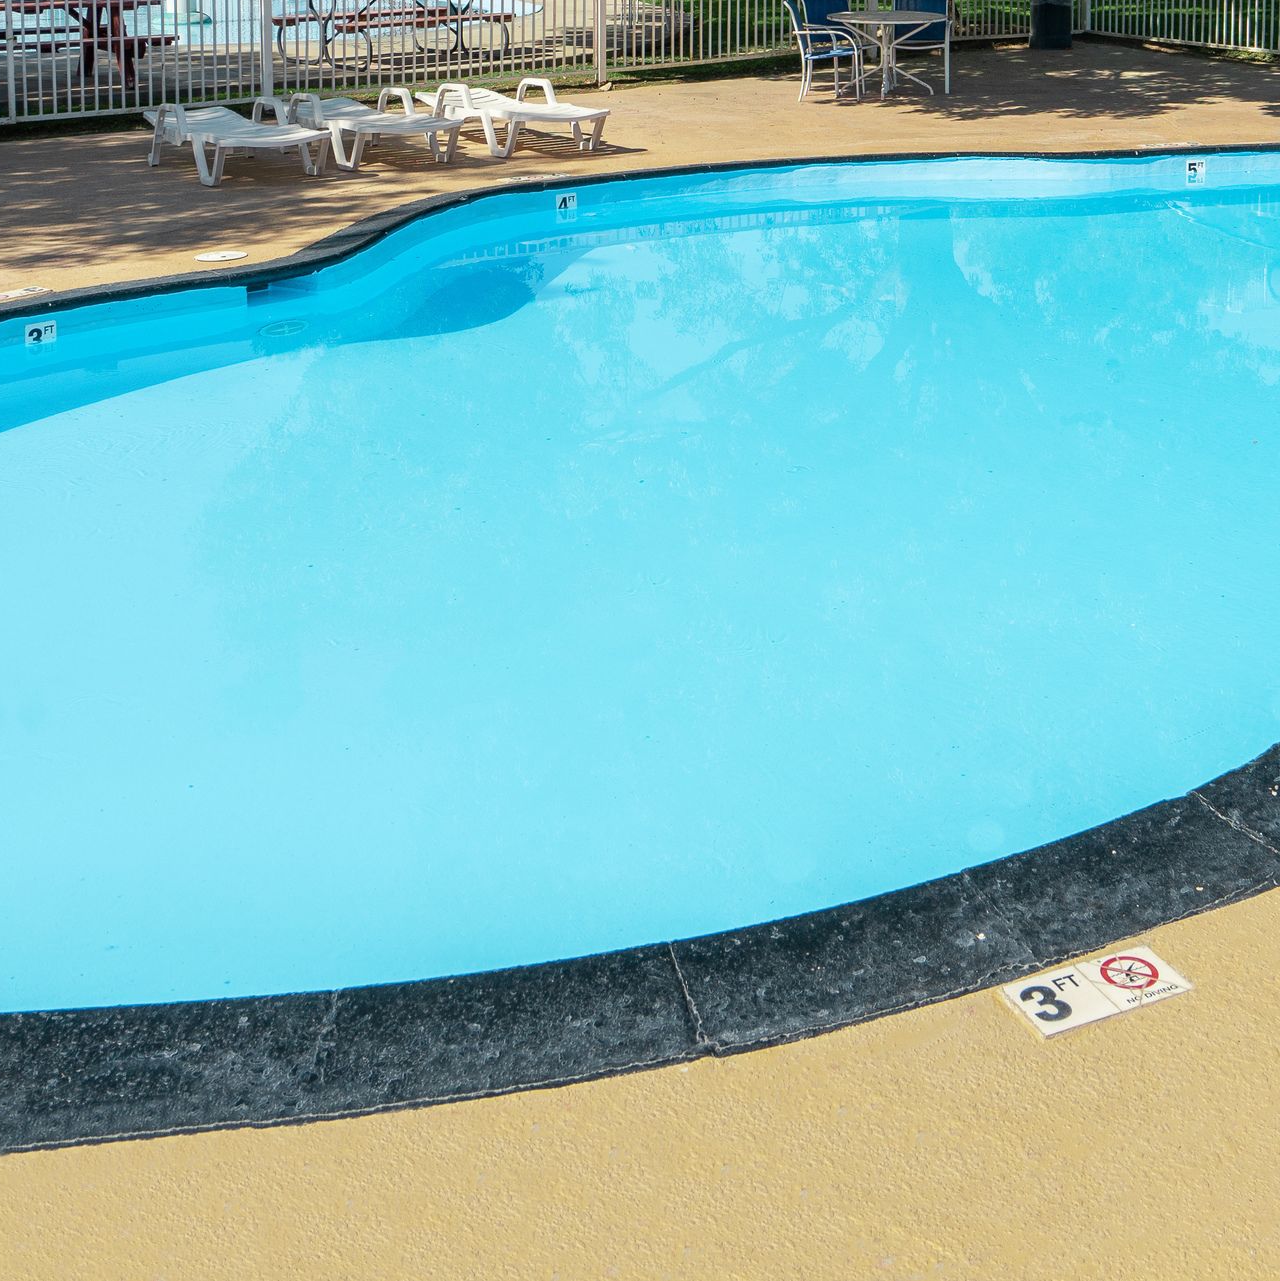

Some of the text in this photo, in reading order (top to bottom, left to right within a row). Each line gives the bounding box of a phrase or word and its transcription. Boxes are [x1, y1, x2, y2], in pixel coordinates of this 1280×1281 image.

[558, 195, 576, 209] 4 FT
[44, 324, 55, 335] FT
[1020, 974, 1080, 1022] 3 FT
[1126, 983, 1179, 1005] NO DIVING
